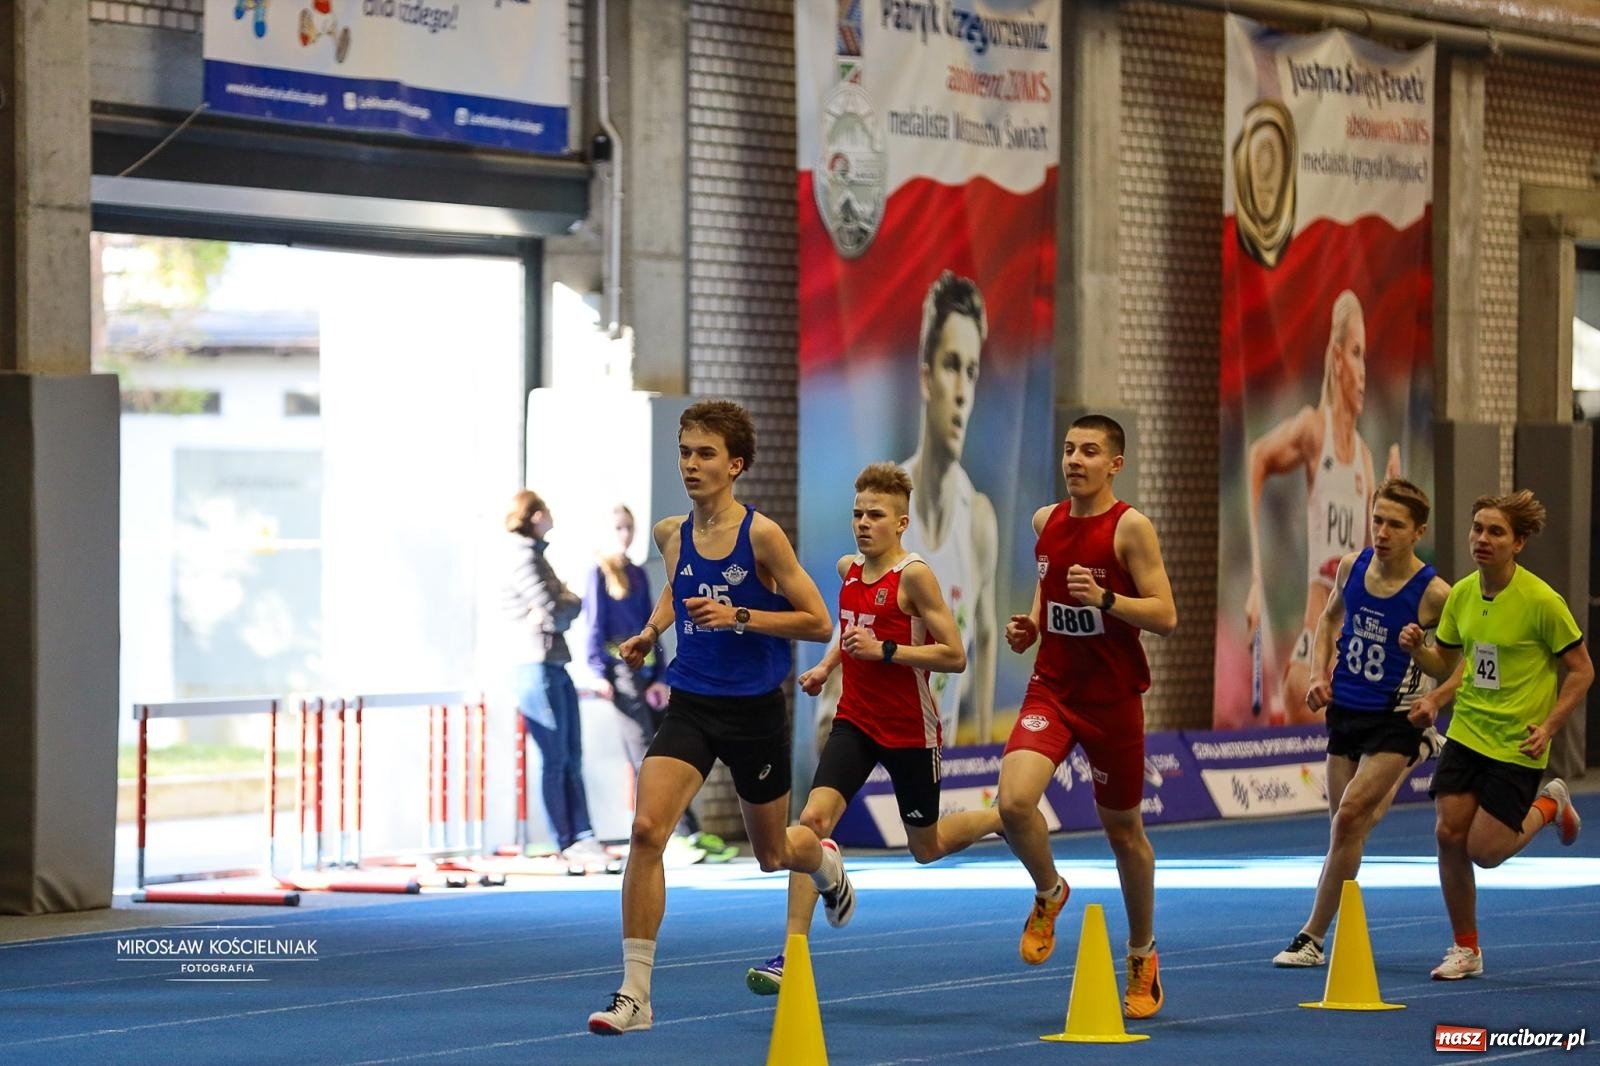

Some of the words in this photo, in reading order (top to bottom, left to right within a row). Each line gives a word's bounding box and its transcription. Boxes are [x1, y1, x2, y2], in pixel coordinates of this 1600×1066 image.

[1327, 501, 1355, 550] POL
[1052, 605, 1096, 633] 880
[1346, 636, 1386, 682] 88
[1476, 658, 1497, 681] 42
